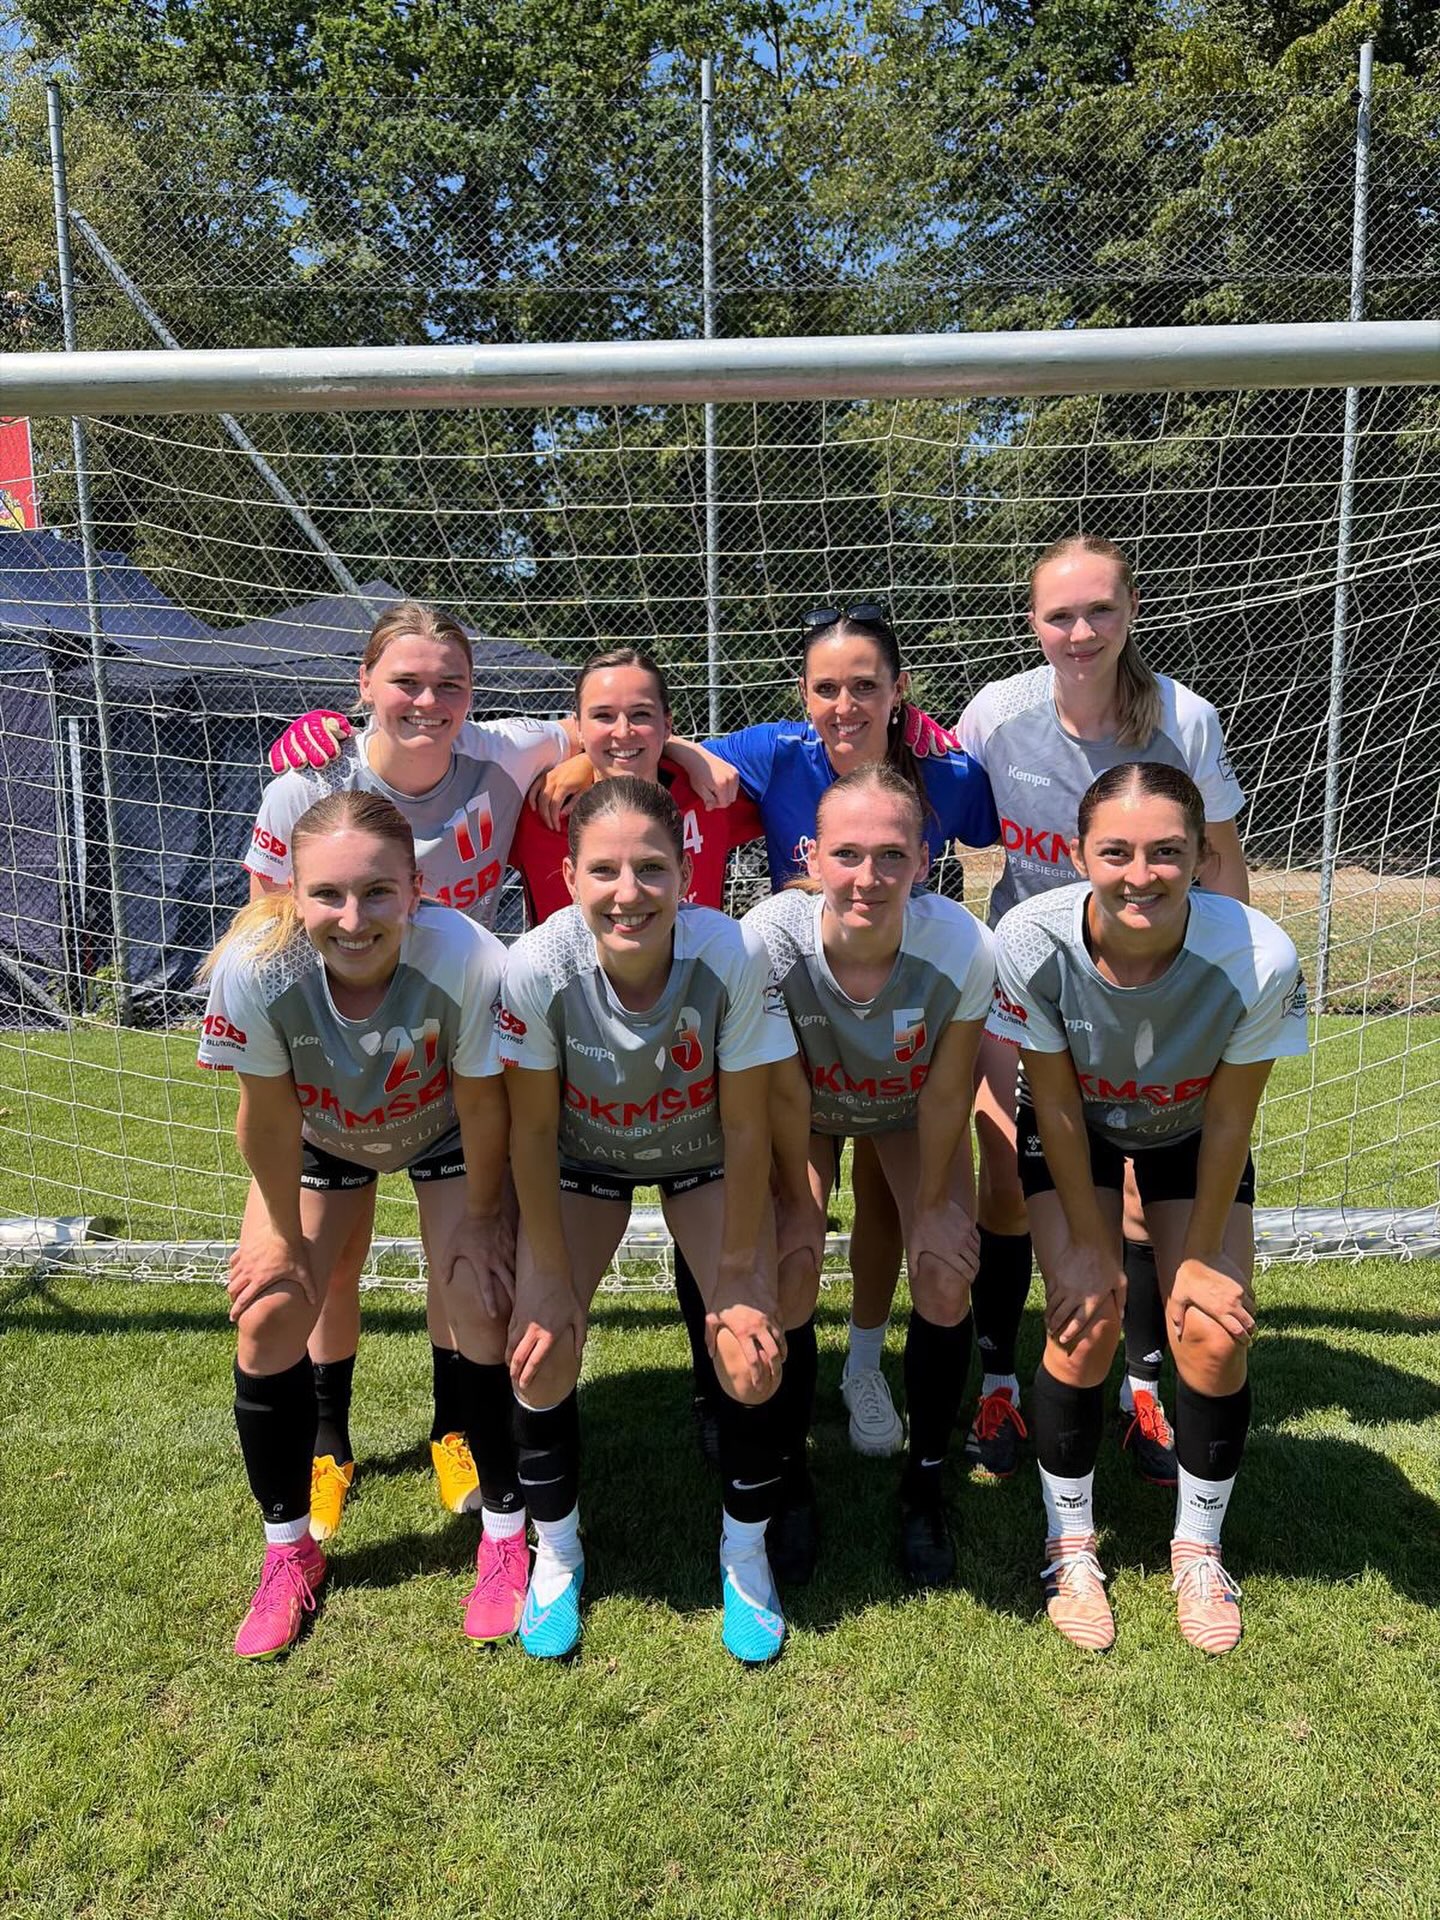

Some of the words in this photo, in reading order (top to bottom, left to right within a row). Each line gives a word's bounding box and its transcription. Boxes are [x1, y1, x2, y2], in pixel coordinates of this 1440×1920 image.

[1008, 764, 1051, 787] Kempa
[443, 790, 494, 864] 17
[1020, 859, 1077, 880] BESIEGEN
[566, 1034, 616, 1062] Kempa
[670, 1006, 704, 1073] 3
[892, 1007, 927, 1064] 5
[564, 1080, 687, 1127] DKMS
[591, 1183, 620, 1197] Kempa
